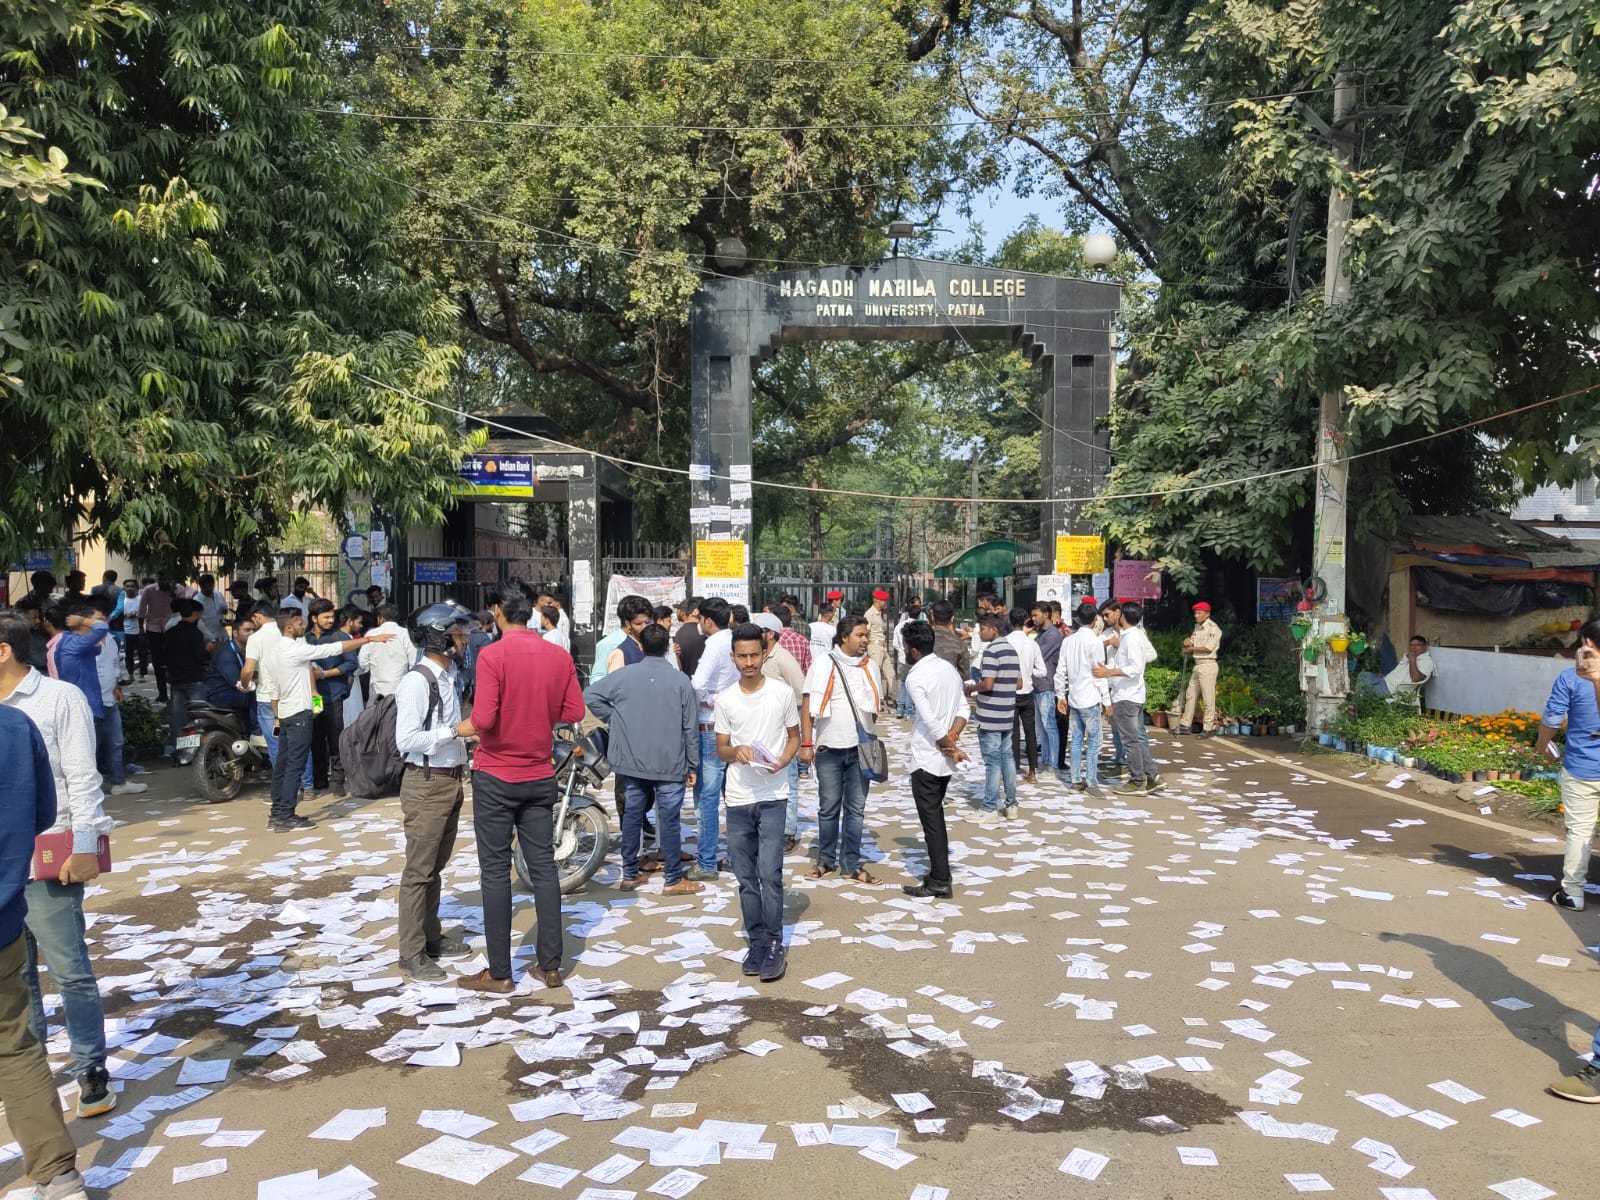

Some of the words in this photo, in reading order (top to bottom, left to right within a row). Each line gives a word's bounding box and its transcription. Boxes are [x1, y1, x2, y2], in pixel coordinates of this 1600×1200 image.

[780, 279, 854, 297] MAGADH
[869, 279, 936, 297] MAHILA
[949, 278, 1026, 297] COLLEGE
[816, 304, 853, 317] PATNA
[948, 303, 985, 316] PATNA
[499, 460, 516, 472] Indian
[516, 460, 530, 472] Bank
